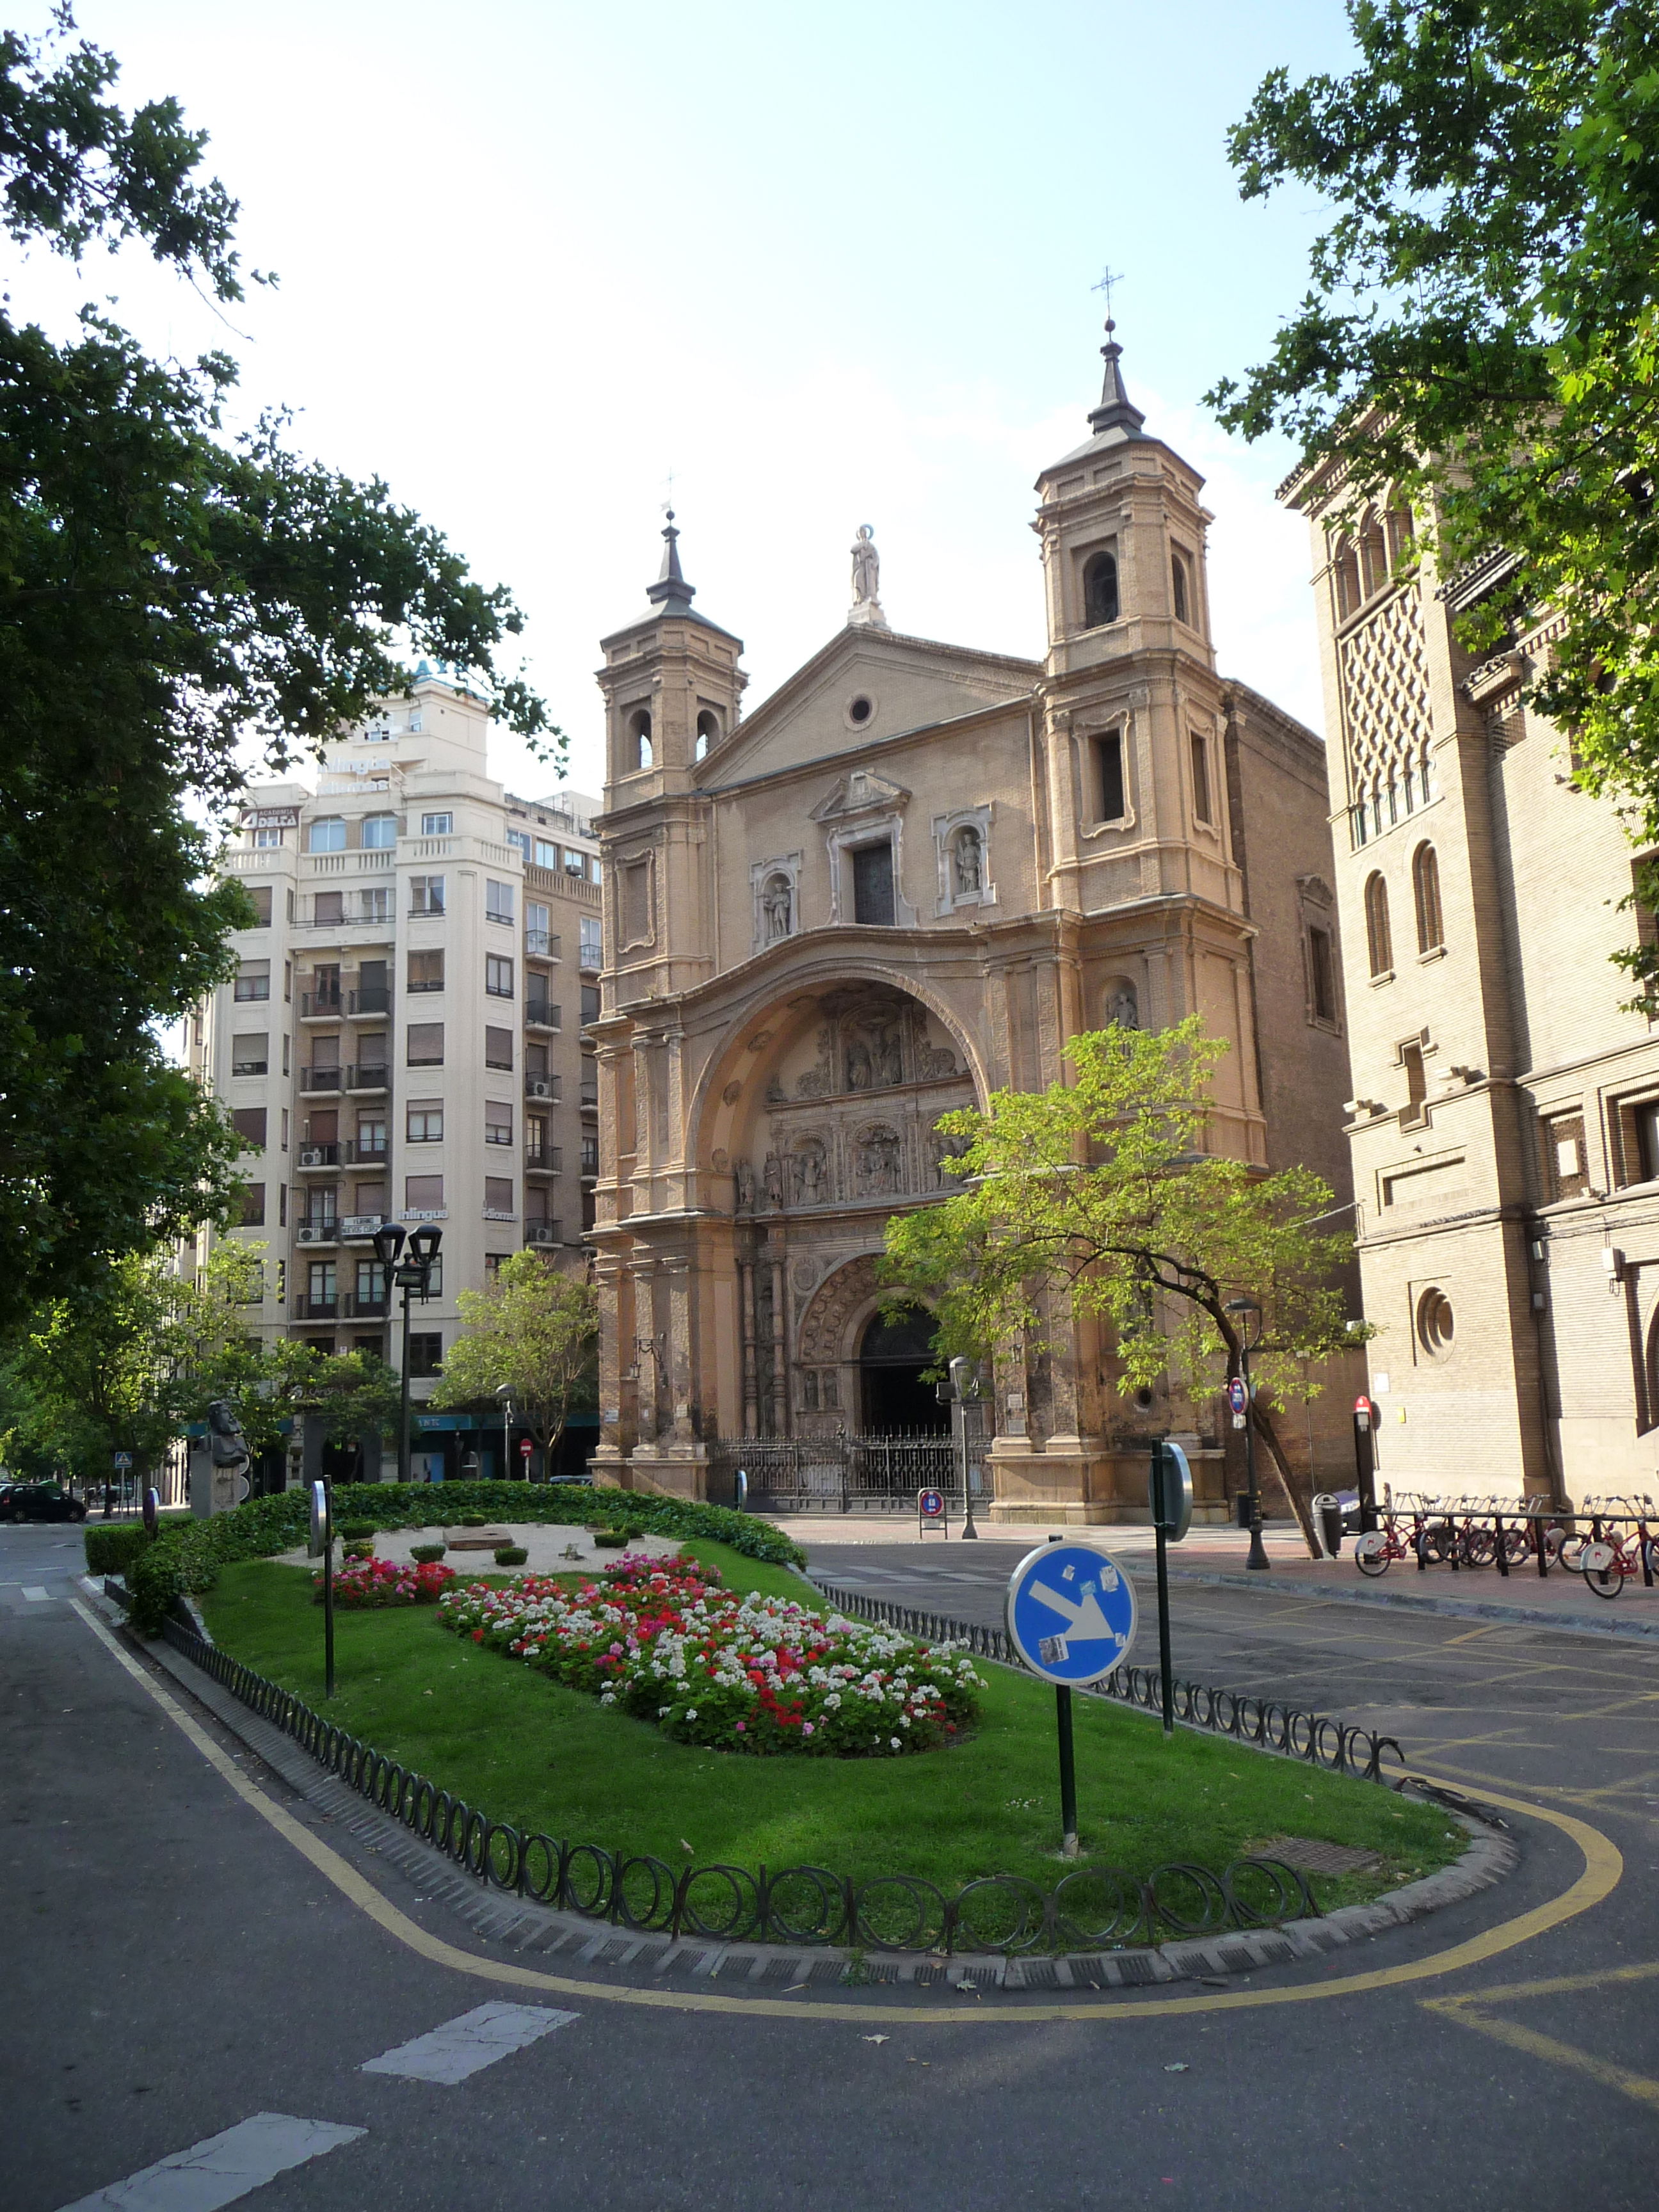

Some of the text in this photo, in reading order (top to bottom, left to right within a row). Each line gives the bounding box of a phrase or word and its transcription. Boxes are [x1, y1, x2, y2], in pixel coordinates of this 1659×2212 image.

[259, 815, 297, 828] DELTA
[398, 1207, 448, 1222] inlingua
[482, 1208, 520, 1221] idiomas
